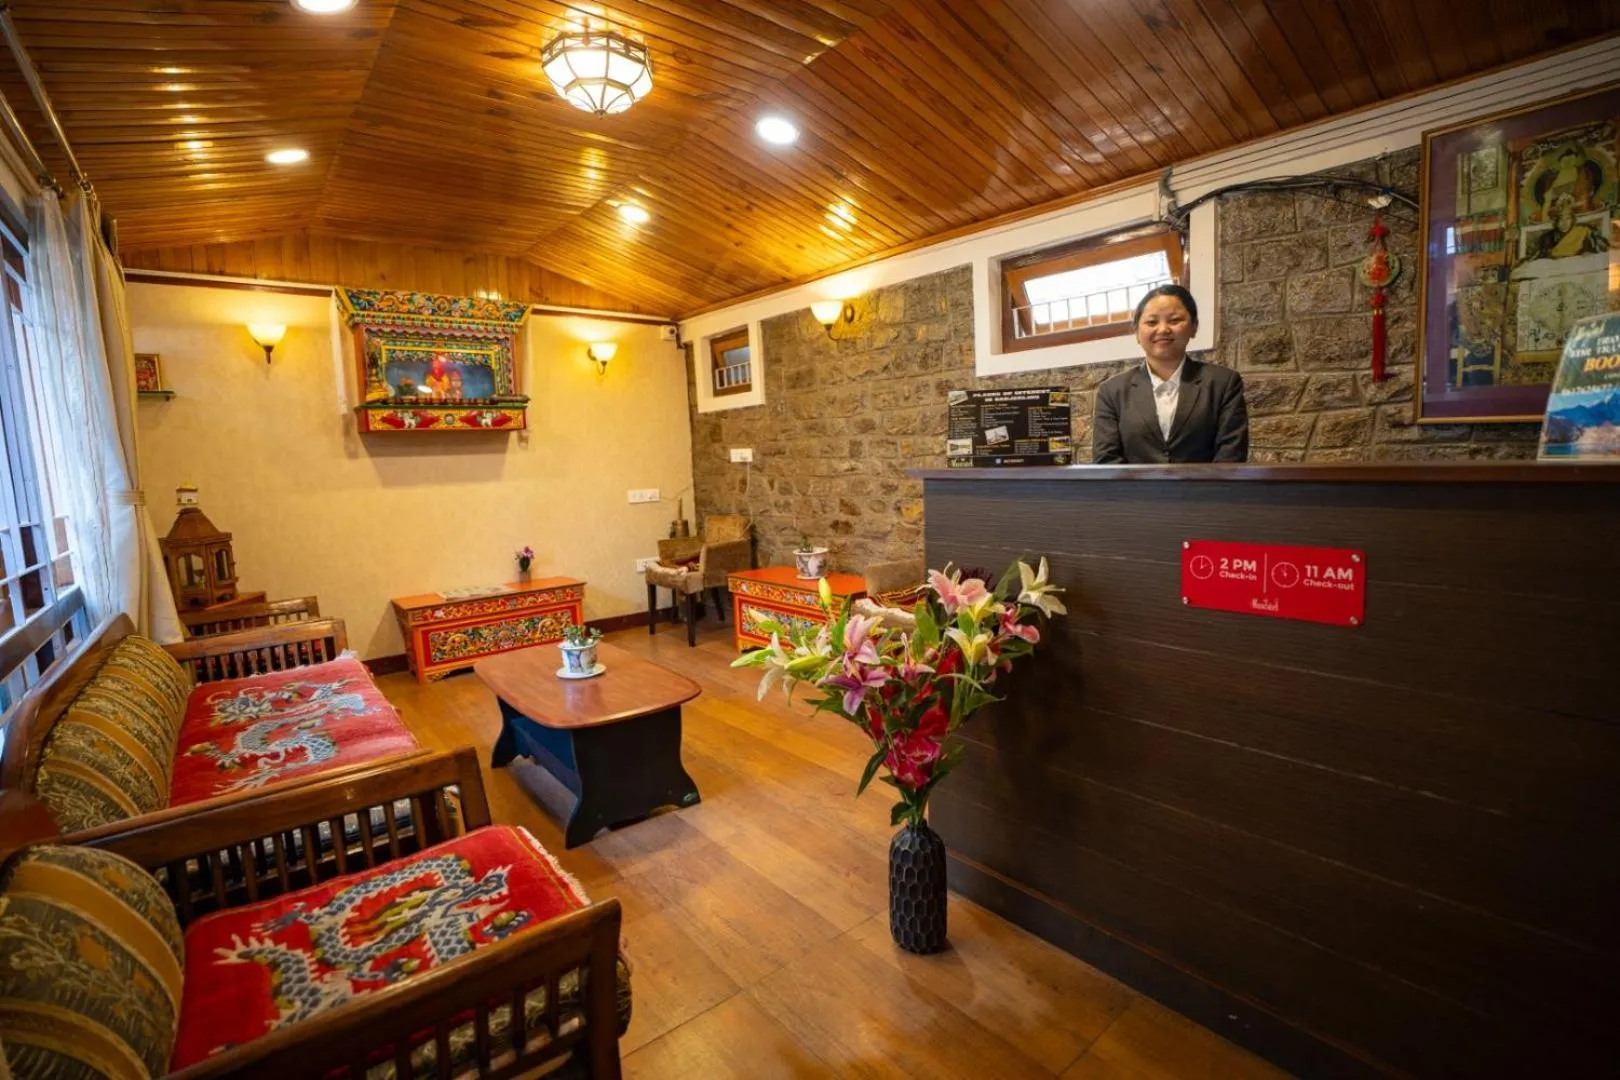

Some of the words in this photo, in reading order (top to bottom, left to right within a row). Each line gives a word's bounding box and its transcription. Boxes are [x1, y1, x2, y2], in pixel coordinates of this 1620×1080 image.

[1220, 558, 1229, 570] 2
[1232, 558, 1257, 572] PM
[1219, 570, 1257, 581] Check-in
[1304, 564, 1319, 578] 11
[1323, 566, 1353, 581] AM
[1303, 578, 1354, 591] Check-out
